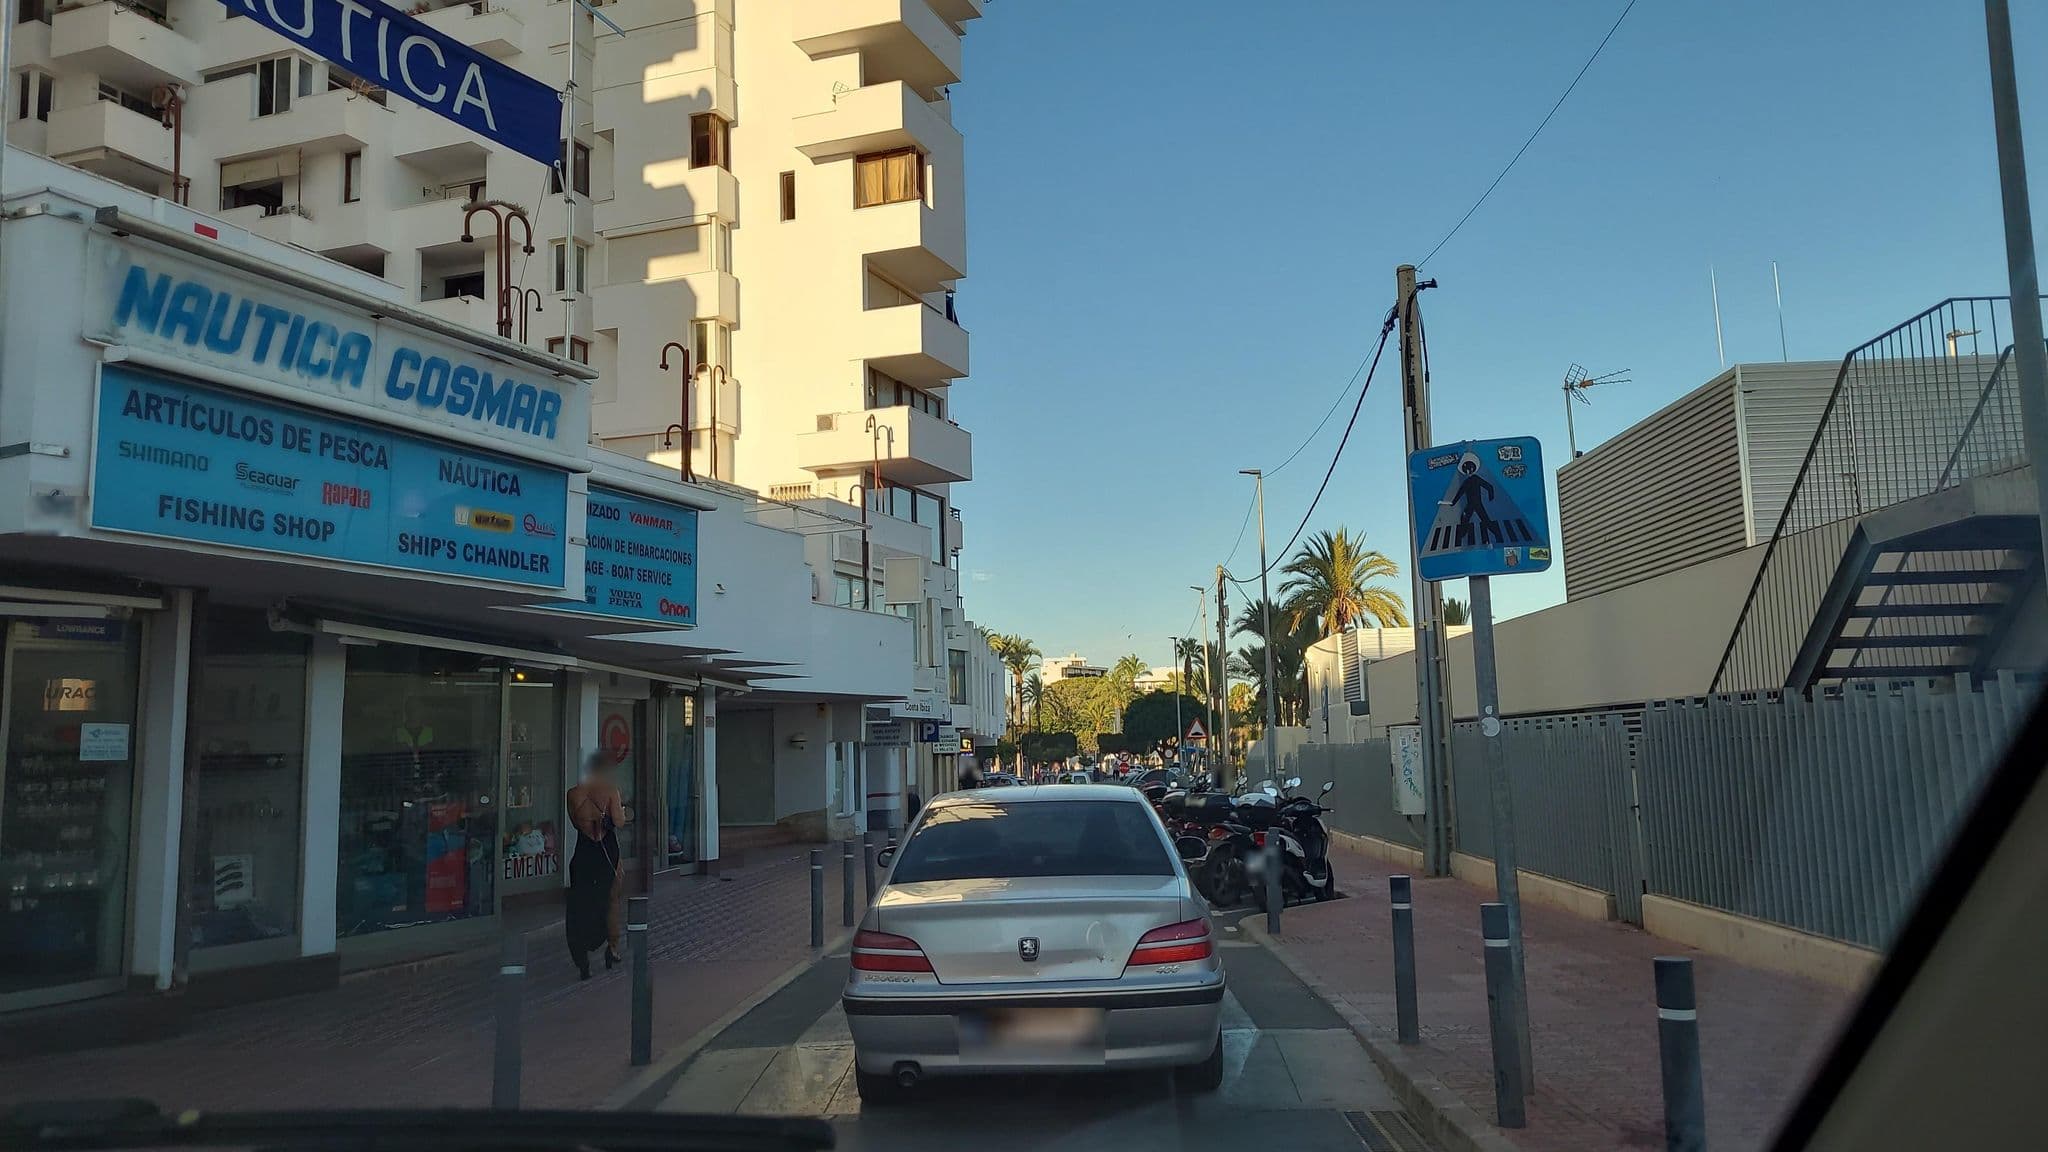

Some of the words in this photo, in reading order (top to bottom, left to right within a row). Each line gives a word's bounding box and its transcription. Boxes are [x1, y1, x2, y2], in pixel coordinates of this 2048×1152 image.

[241, 0, 498, 132] UTICA
[114, 265, 374, 389] NAUTICA
[385, 347, 563, 440] COSMAR
[122, 390, 273, 445] ARTÍCULOS
[281, 423, 312, 453] DE
[319, 432, 389, 470] PESCA
[439, 456, 521, 497] NÁUTICA
[158, 495, 265, 532] FISHING
[273, 513, 335, 542] SHOP
[587, 501, 620, 521] IZADO
[629, 511, 673, 530] YANMAR
[398, 533, 457, 560] SHIP'S
[463, 543, 549, 573] CHANDLER
[615, 539, 625, 554] DE
[628, 541, 692, 566] EMBARCACIONES
[611, 564, 635, 581] BOAT
[636, 568, 672, 586] SERVICE
[608, 598, 643, 608] PENTA
[609, 588, 642, 599] VOLVO
[923, 723, 936, 740] P
